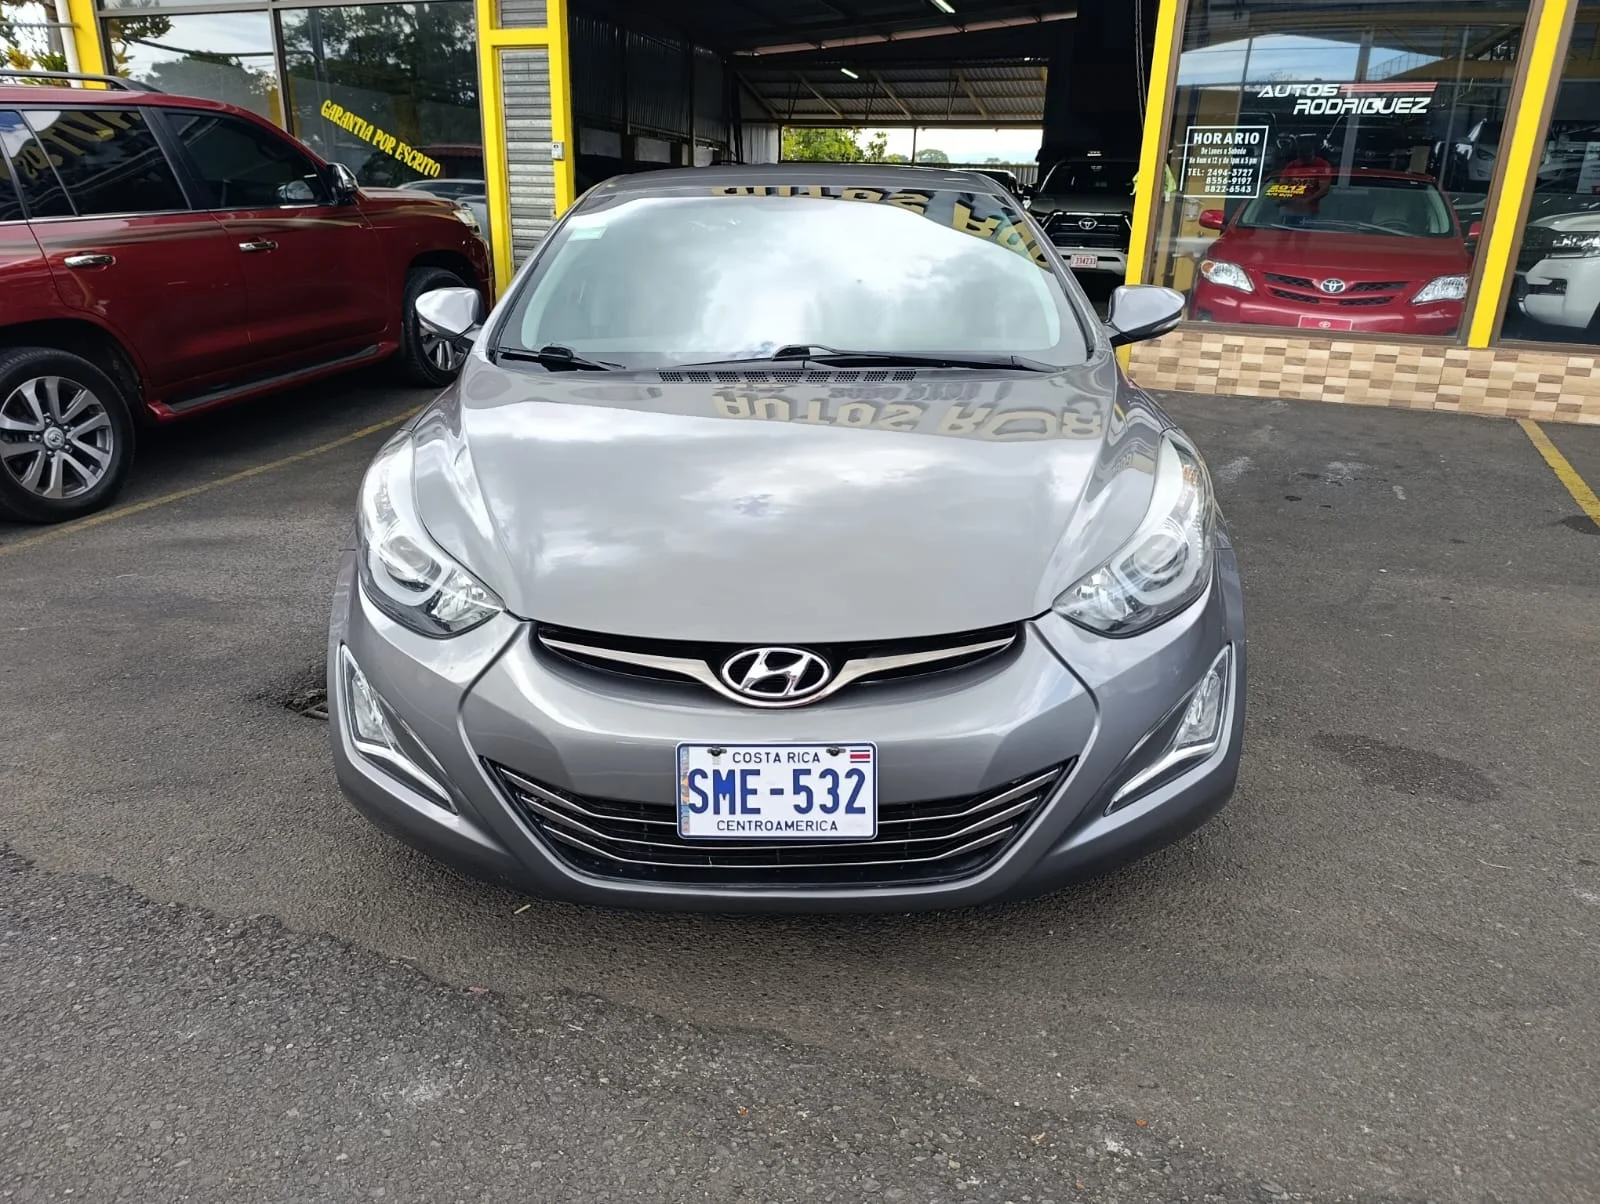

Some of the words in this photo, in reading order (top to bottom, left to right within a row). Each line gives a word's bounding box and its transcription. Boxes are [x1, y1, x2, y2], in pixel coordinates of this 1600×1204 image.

[1257, 83, 1340, 98] AUTOS
[1293, 97, 1431, 115] RODRIGUEZ
[321, 100, 374, 142] GARANTIA
[372, 129, 396, 155] POR
[395, 142, 440, 178] ESCRITO
[1193, 132, 1260, 145] HORARIO
[1187, 168, 1205, 177] TEL:
[732, 751, 781, 764] COSTA
[787, 751, 821, 764] RICA
[688, 768, 866, 815] SME-532
[716, 820, 838, 832] CENTROAMERICA
